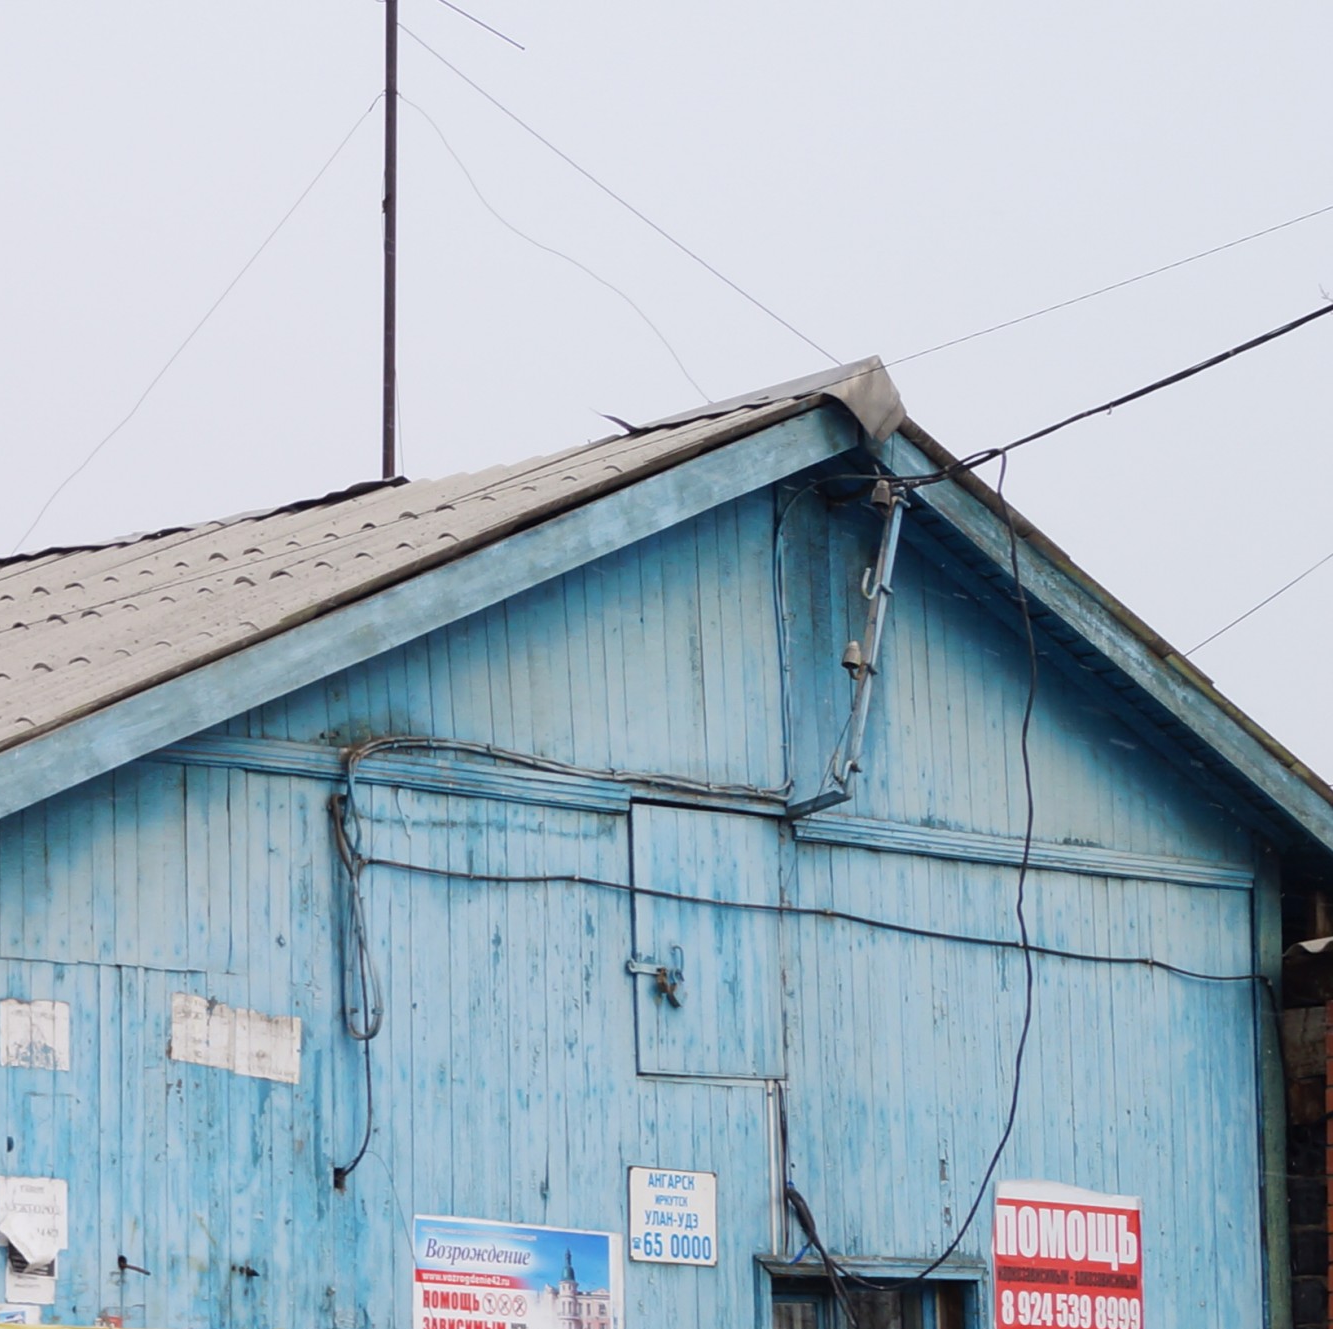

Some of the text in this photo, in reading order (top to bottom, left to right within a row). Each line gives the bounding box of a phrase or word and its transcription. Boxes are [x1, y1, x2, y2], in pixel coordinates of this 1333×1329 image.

[648, 1172, 695, 1190] АНГАРСК
[655, 1195, 688, 1207] ИРКУТСК
[644, 1232, 712, 1260] 65 0000
[996, 1205, 1138, 1271] ПОМОЩЬ
[424, 1237, 531, 1266] Возрождение
[421, 1272, 511, 1287] www.vozrogdenie42.ru
[423, 1290, 480, 1314] ПОМОЩЬ
[1001, 1290, 1014, 1325] 8
[1018, 1290, 1054, 1326] 924
[1056, 1293, 1092, 1328] 539
